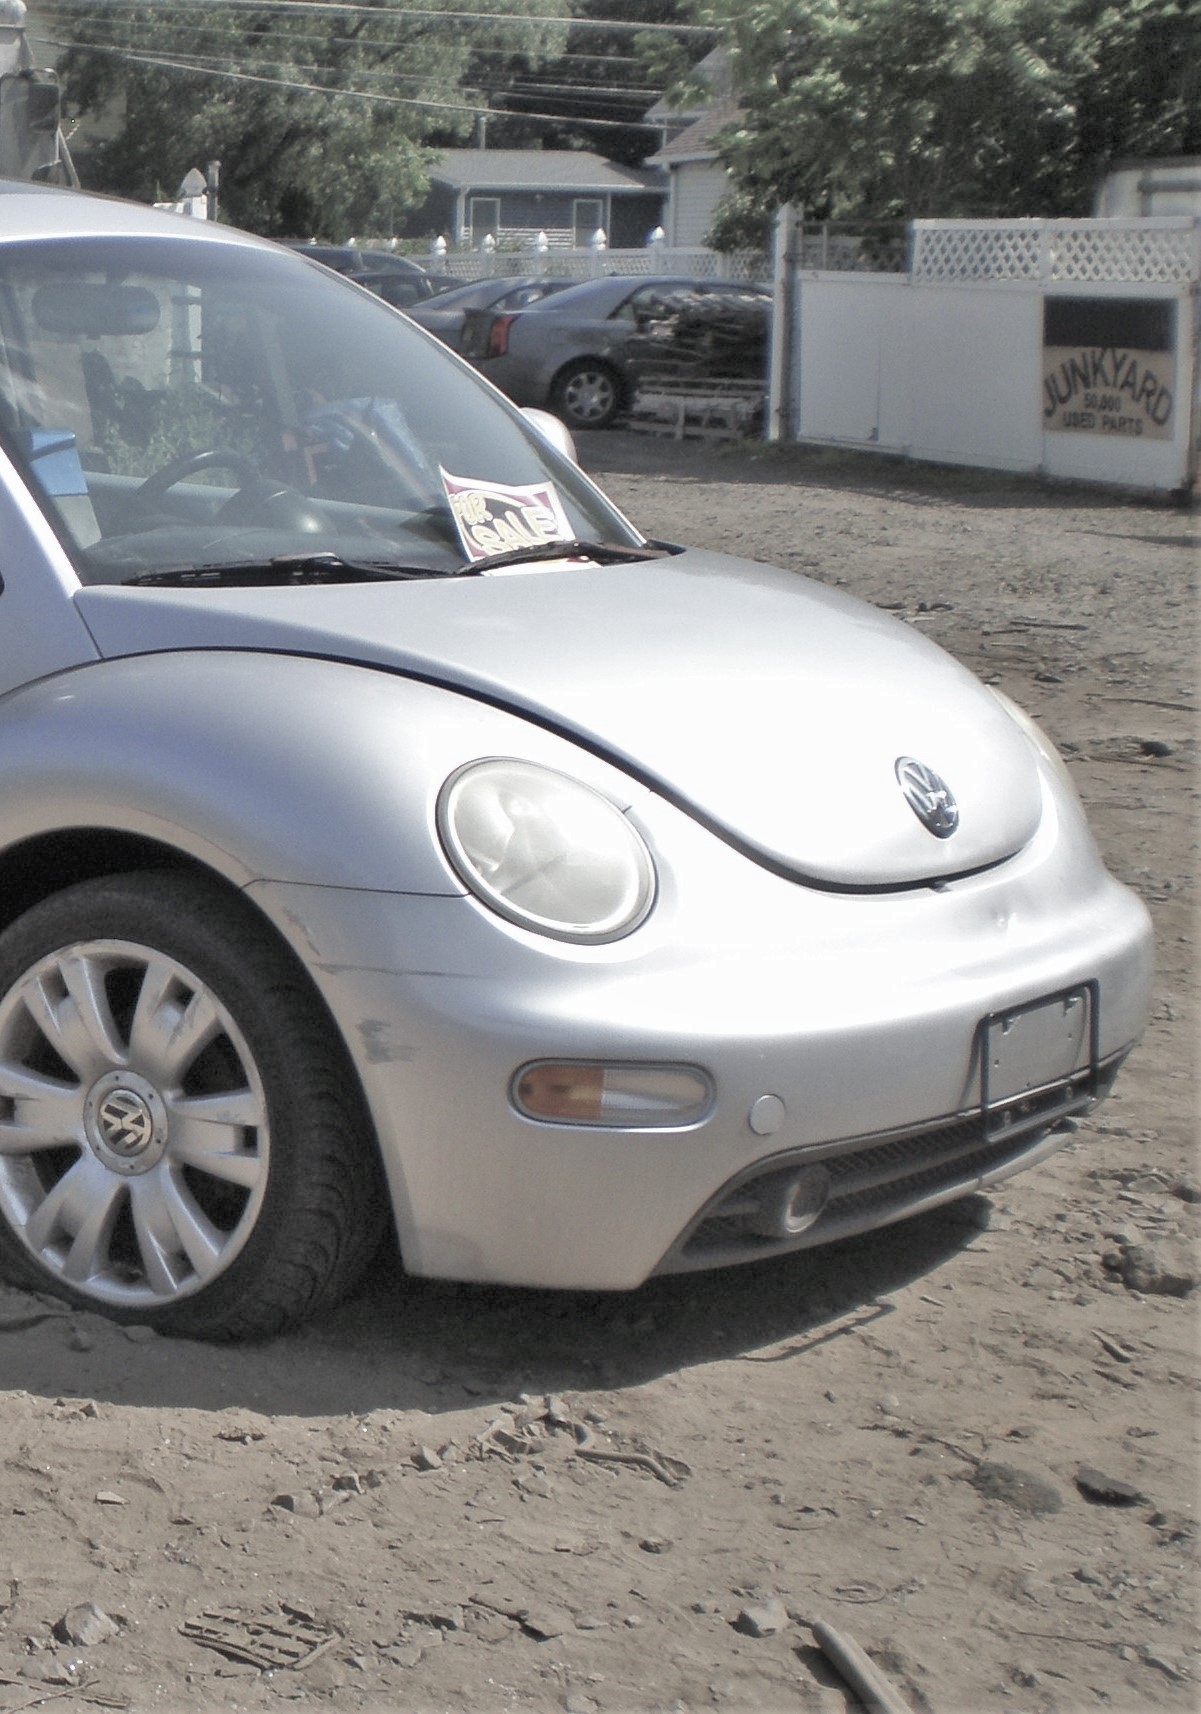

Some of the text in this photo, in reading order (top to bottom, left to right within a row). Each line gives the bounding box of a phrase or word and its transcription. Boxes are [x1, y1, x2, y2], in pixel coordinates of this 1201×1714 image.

[1044, 349, 1173, 426] JUNKYARD
[1063, 411, 1143, 436] USED PARTS
[450, 492, 493, 526] FOR
[471, 506, 560, 557] SALE
